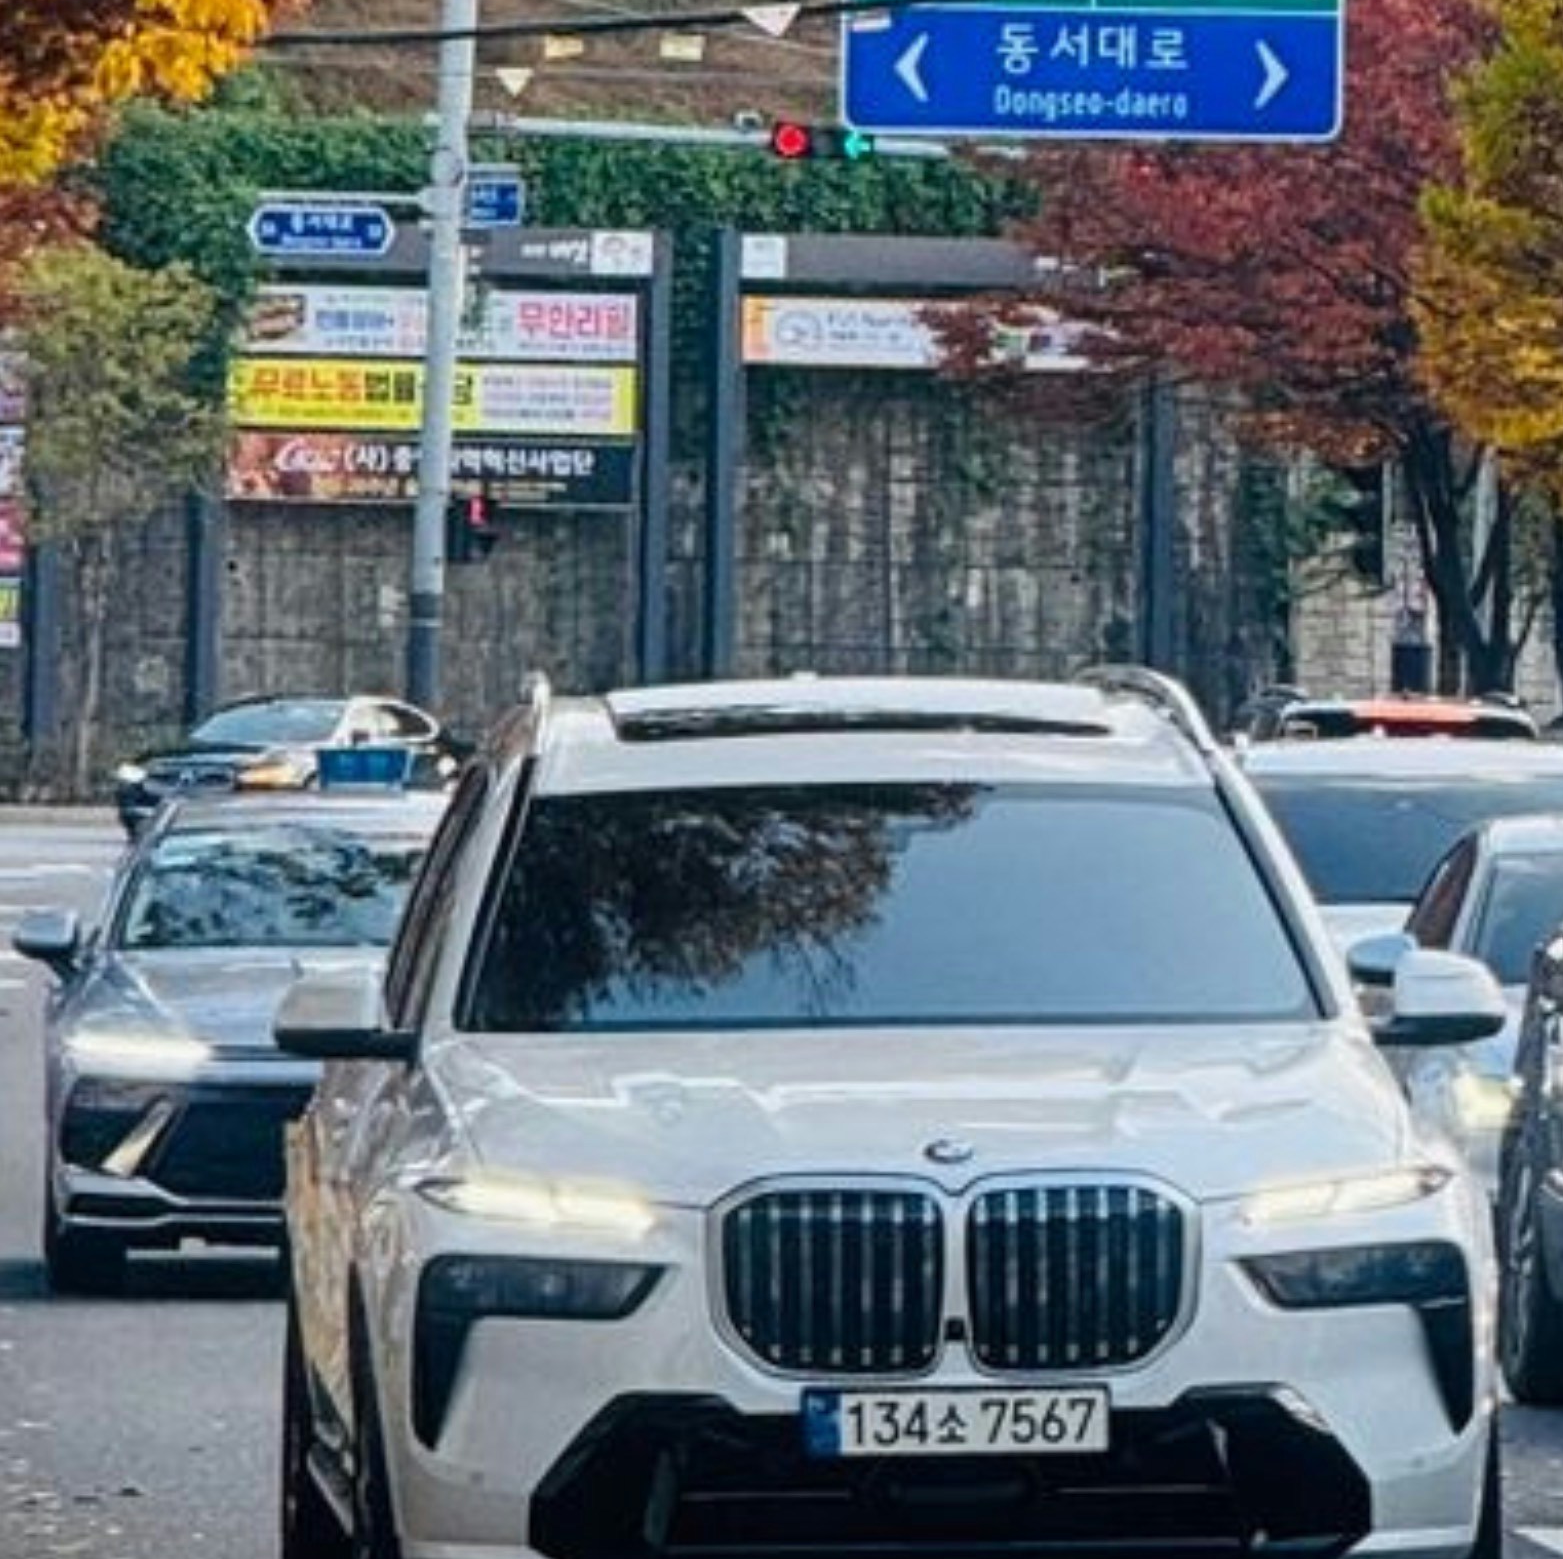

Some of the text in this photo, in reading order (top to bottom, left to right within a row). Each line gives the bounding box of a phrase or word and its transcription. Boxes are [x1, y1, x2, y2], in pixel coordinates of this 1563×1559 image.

[996, 23, 1190, 74] 동서대로
[993, 84, 1188, 121] Dongseo-daero
[847, 1398, 968, 1446] 134소
[979, 1397, 1097, 1445] 7567
